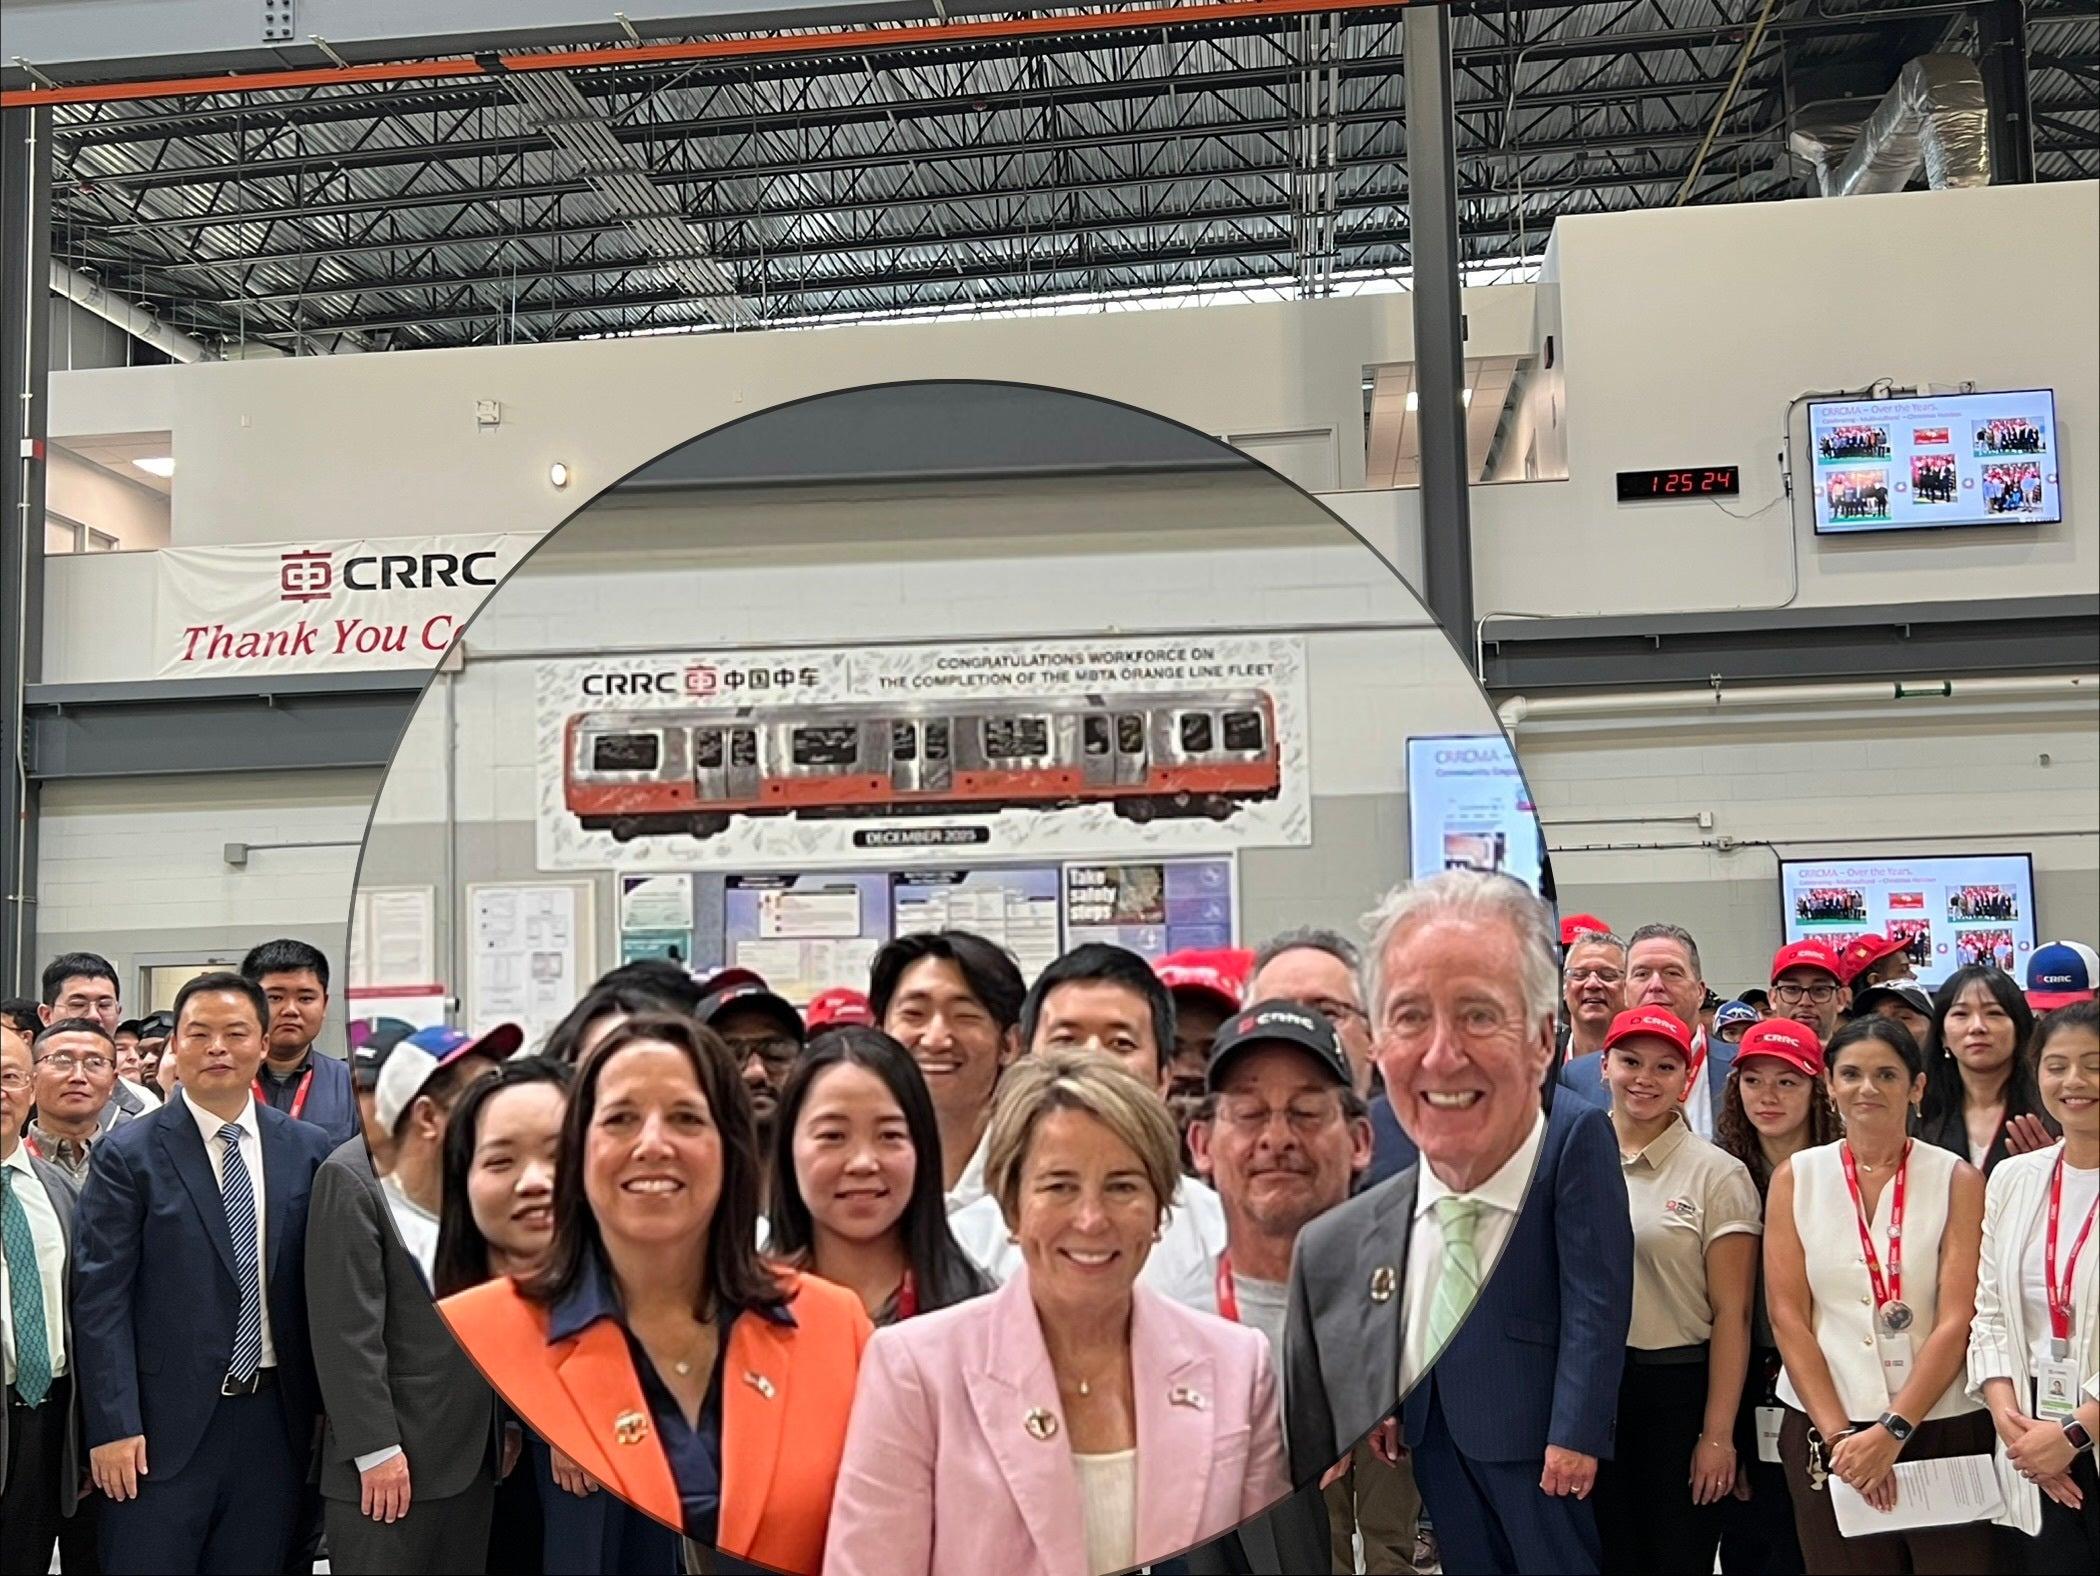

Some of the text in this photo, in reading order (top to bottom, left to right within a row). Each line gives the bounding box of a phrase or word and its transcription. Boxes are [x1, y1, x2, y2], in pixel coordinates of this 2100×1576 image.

[1871, 405, 1893, 414] Over
[1895, 404, 1909, 413] the
[1652, 472, 1730, 492] 1 25 24
[343, 551, 497, 591] CRRC
[180, 620, 319, 661] Thank
[333, 618, 408, 655] You
[937, 647, 1215, 669] CONGRATULATIONS WORKFORCE ON
[582, 672, 677, 696] CRRC
[723, 667, 820, 691] 中国中车
[880, 676, 907, 689] THE
[912, 672, 1012, 688] COMPLETION
[1016, 672, 1035, 684] OF
[1041, 670, 1070, 684] THE
[1121, 666, 1185, 681] ORANGE
[1189, 664, 1224, 679] LINE
[1229, 663, 1275, 677] FLEET
[865, 831, 942, 846] DECEMBER
[1070, 869, 1105, 885] Take
[1847, 867, 1868, 877] Over
[1870, 867, 1885, 876] the
[1070, 887, 1117, 904] safety
[1070, 905, 1112, 922] steps
[2043, 975, 2072, 984] CRRC
[1643, 1016, 1677, 1034] CRRC
[1763, 1033, 1800, 1048] CRRC
